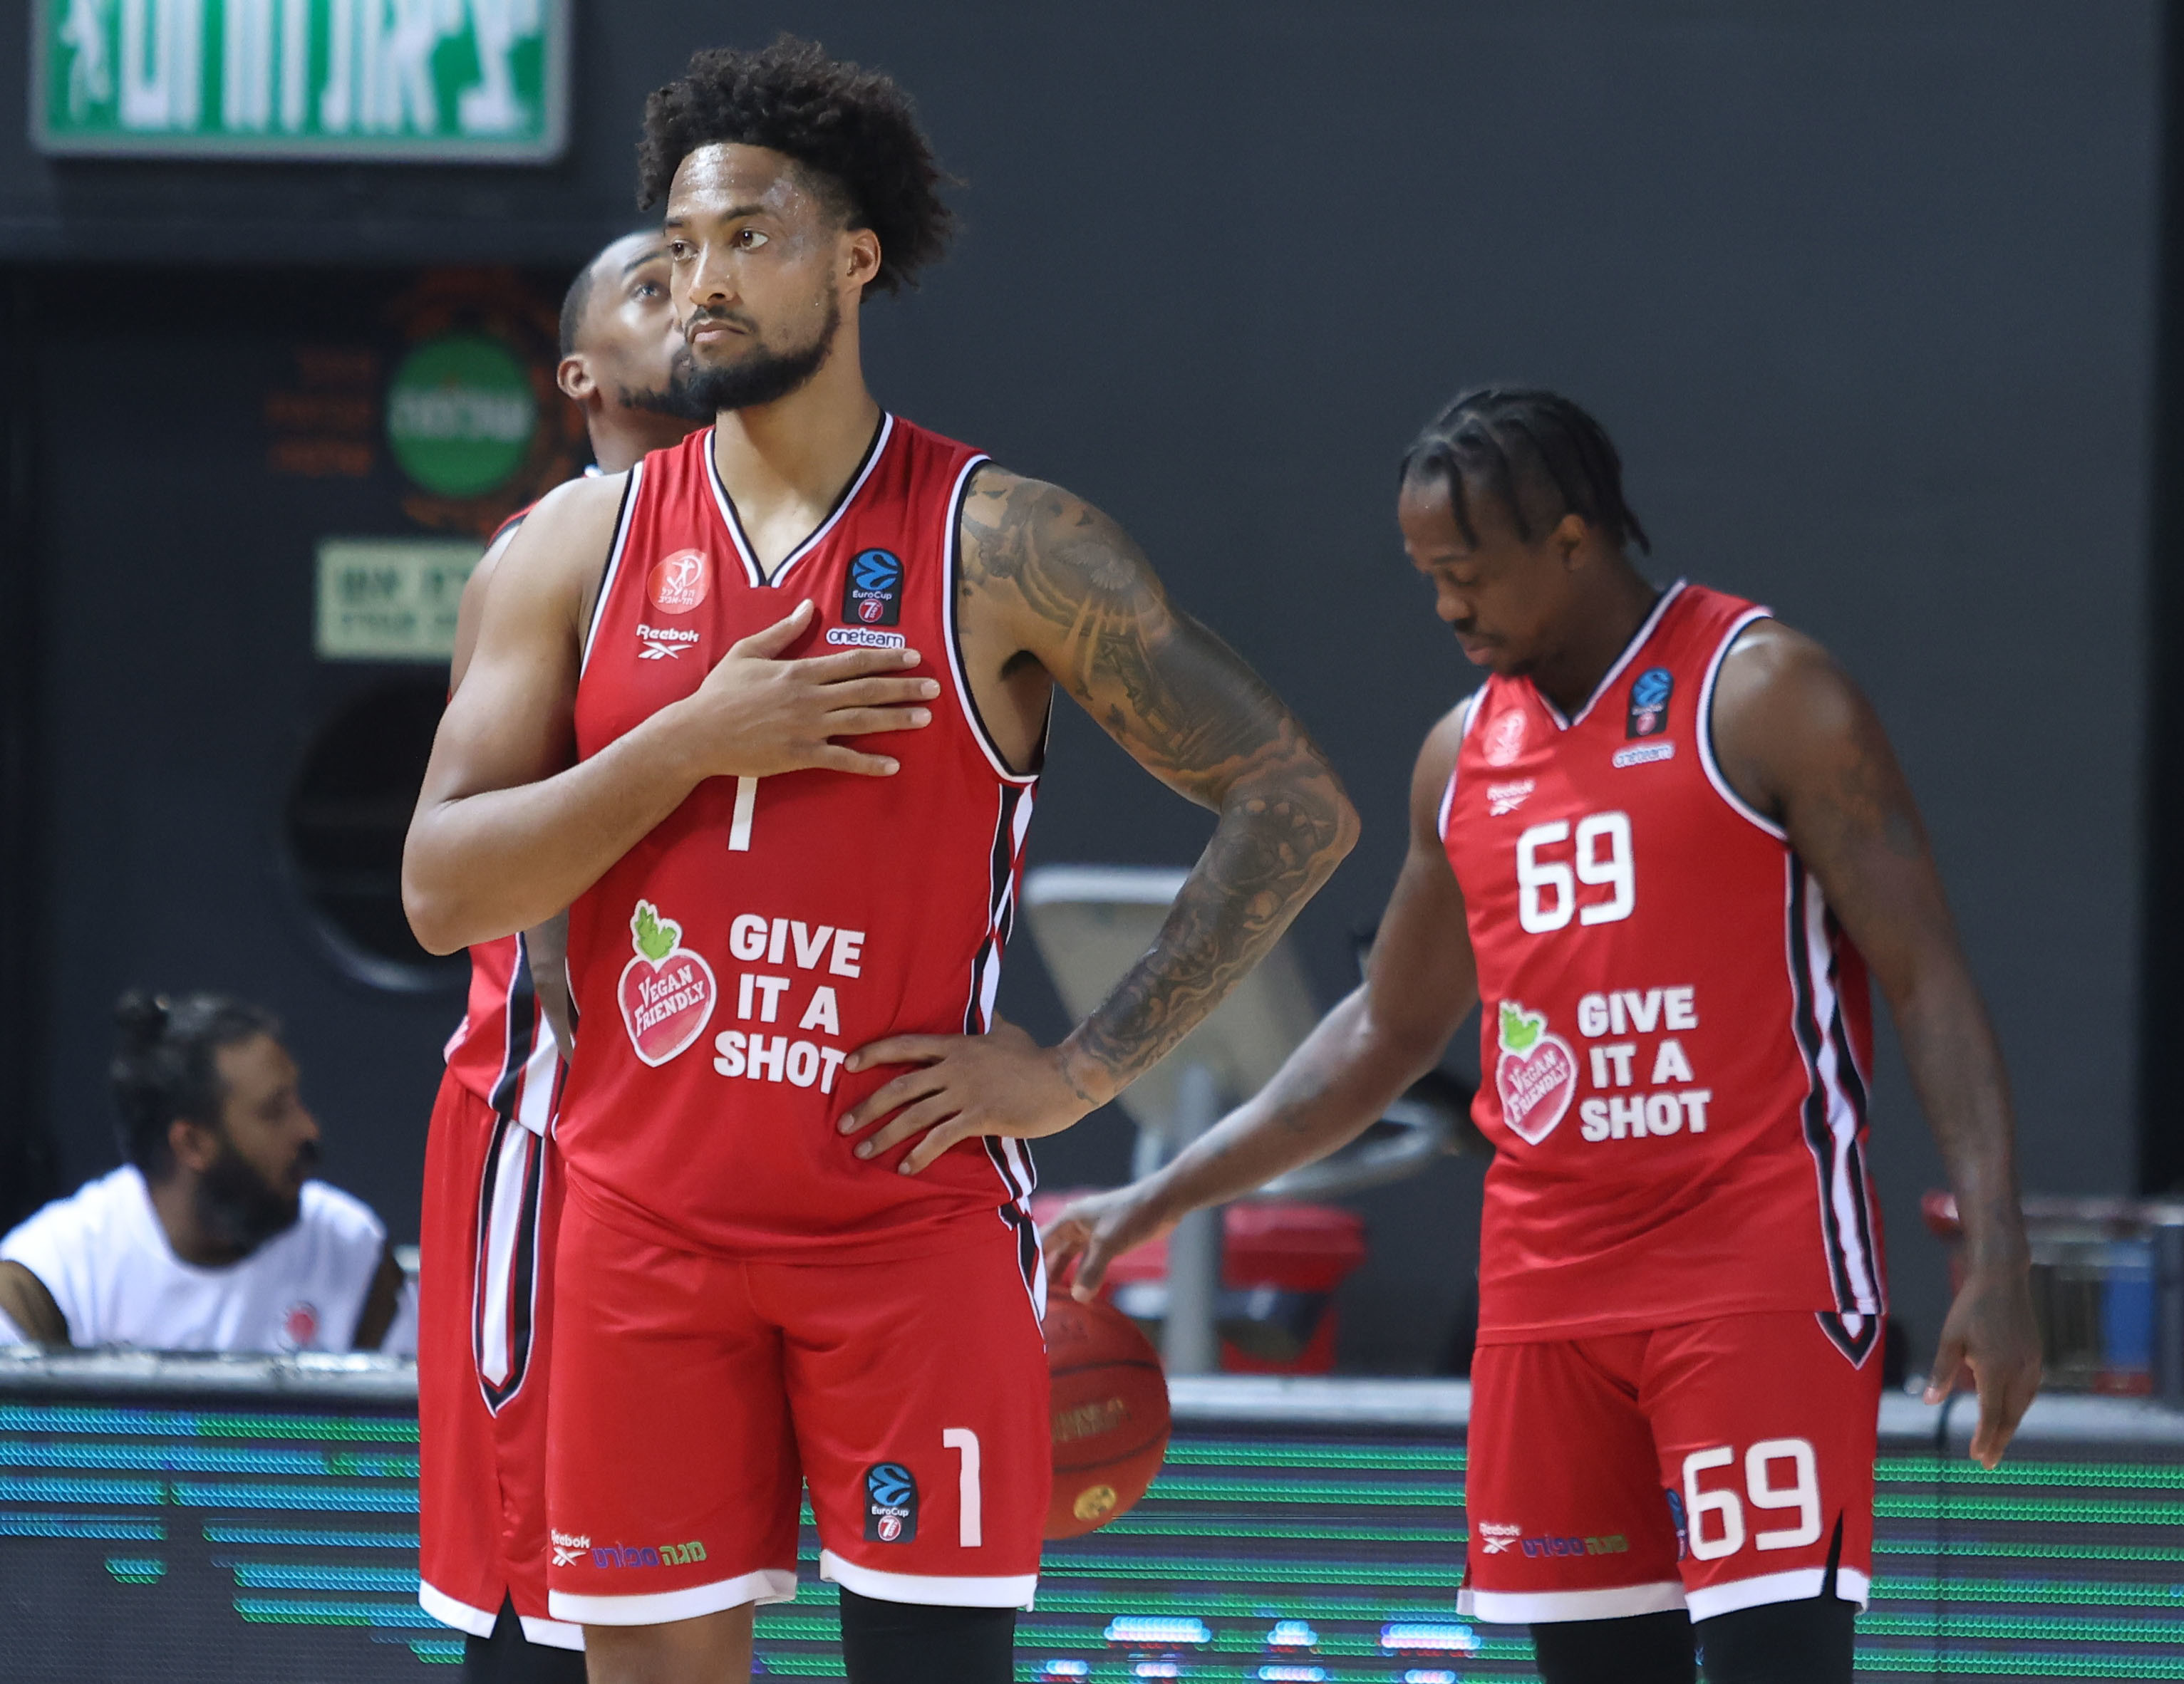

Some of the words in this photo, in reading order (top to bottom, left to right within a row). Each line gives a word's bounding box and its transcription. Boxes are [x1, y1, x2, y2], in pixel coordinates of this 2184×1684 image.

[852, 590, 893, 601] EuroCup
[636, 624, 700, 643] Reebok
[828, 628, 904, 648] oneteam
[1516, 810, 1635, 934] 69
[729, 913, 866, 979] GIVE
[634, 980, 705, 1038] FRIENDLY
[638, 964, 693, 1008] VEGAN
[737, 973, 790, 1023] IT
[798, 984, 840, 1036] A
[1577, 986, 1699, 1037] GIVE
[713, 1030, 847, 1095] SHOT
[1589, 1043, 1636, 1088] IT
[1651, 1039, 1694, 1084] A
[1579, 1089, 1712, 1142] SHOT
[871, 1504, 909, 1518] EuroCup
[943, 1428, 982, 1547] 1
[1682, 1437, 1822, 1561] 69
[551, 1528, 591, 1549] Reebok
[591, 1540, 660, 1568] ספורט
[659, 1541, 707, 1566] מגה
